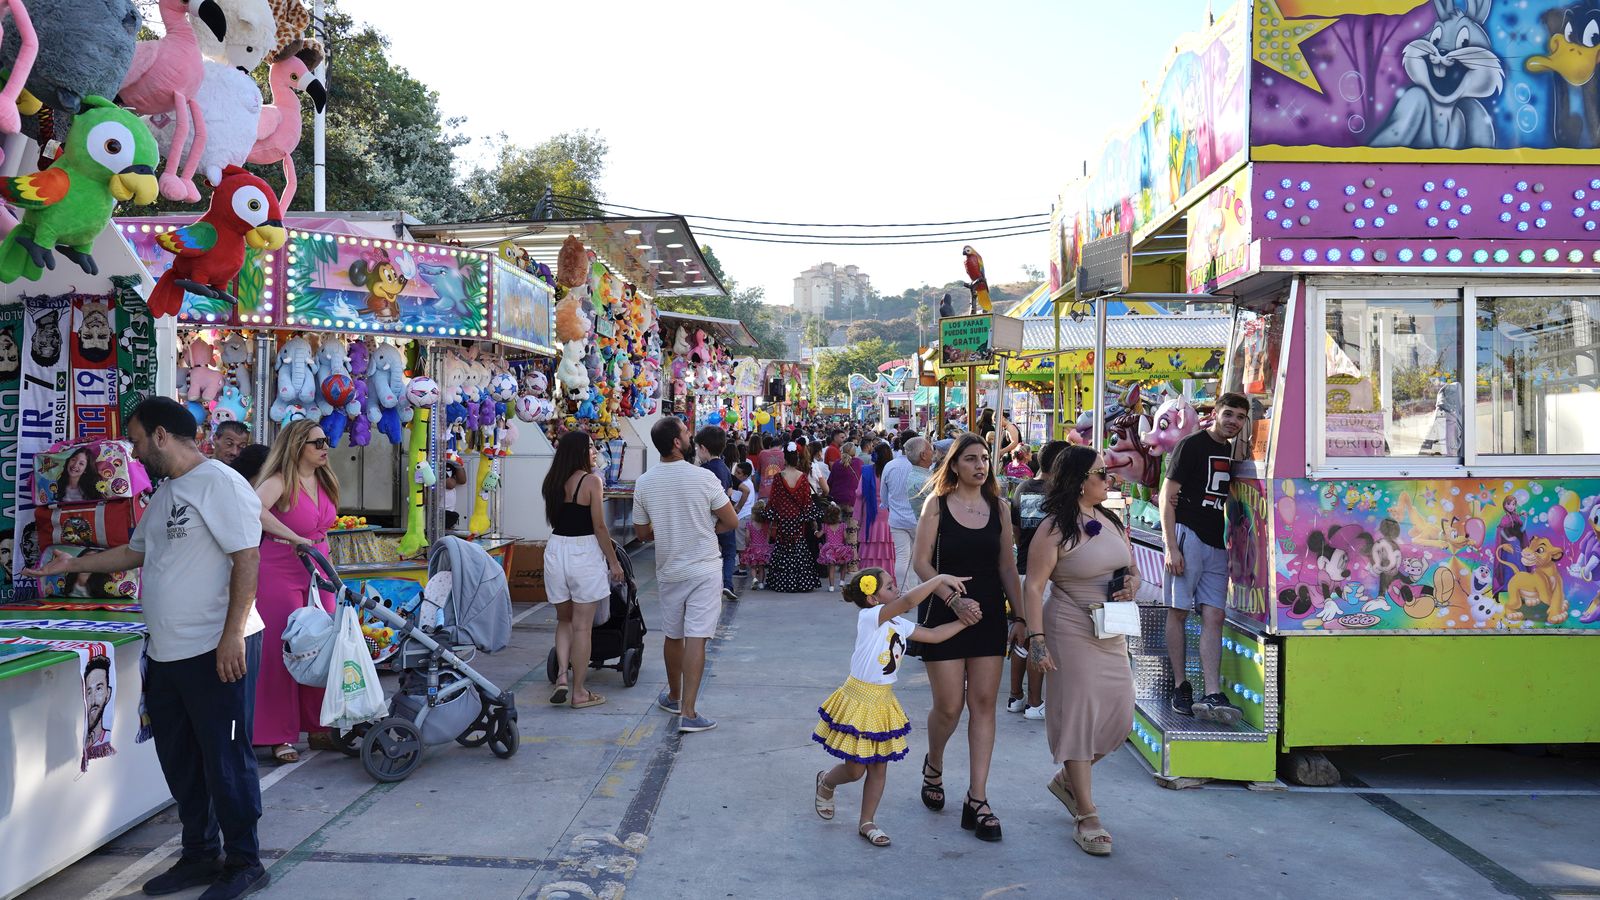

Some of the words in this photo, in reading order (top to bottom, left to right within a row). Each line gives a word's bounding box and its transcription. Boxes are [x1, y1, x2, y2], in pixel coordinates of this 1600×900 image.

[1189, 242, 1246, 291] TAQUILLA
[953, 337, 980, 345] GRATIS
[971, 326, 987, 334] SUBIR
[131, 320, 149, 391] BETIS
[23, 373, 55, 391] 7
[76, 370, 105, 397] 19
[21, 401, 54, 444] JR.
[55, 393, 66, 435] BRASIL
[1327, 436, 1383, 449] TORITO
[1233, 481, 1267, 520] ORITO
